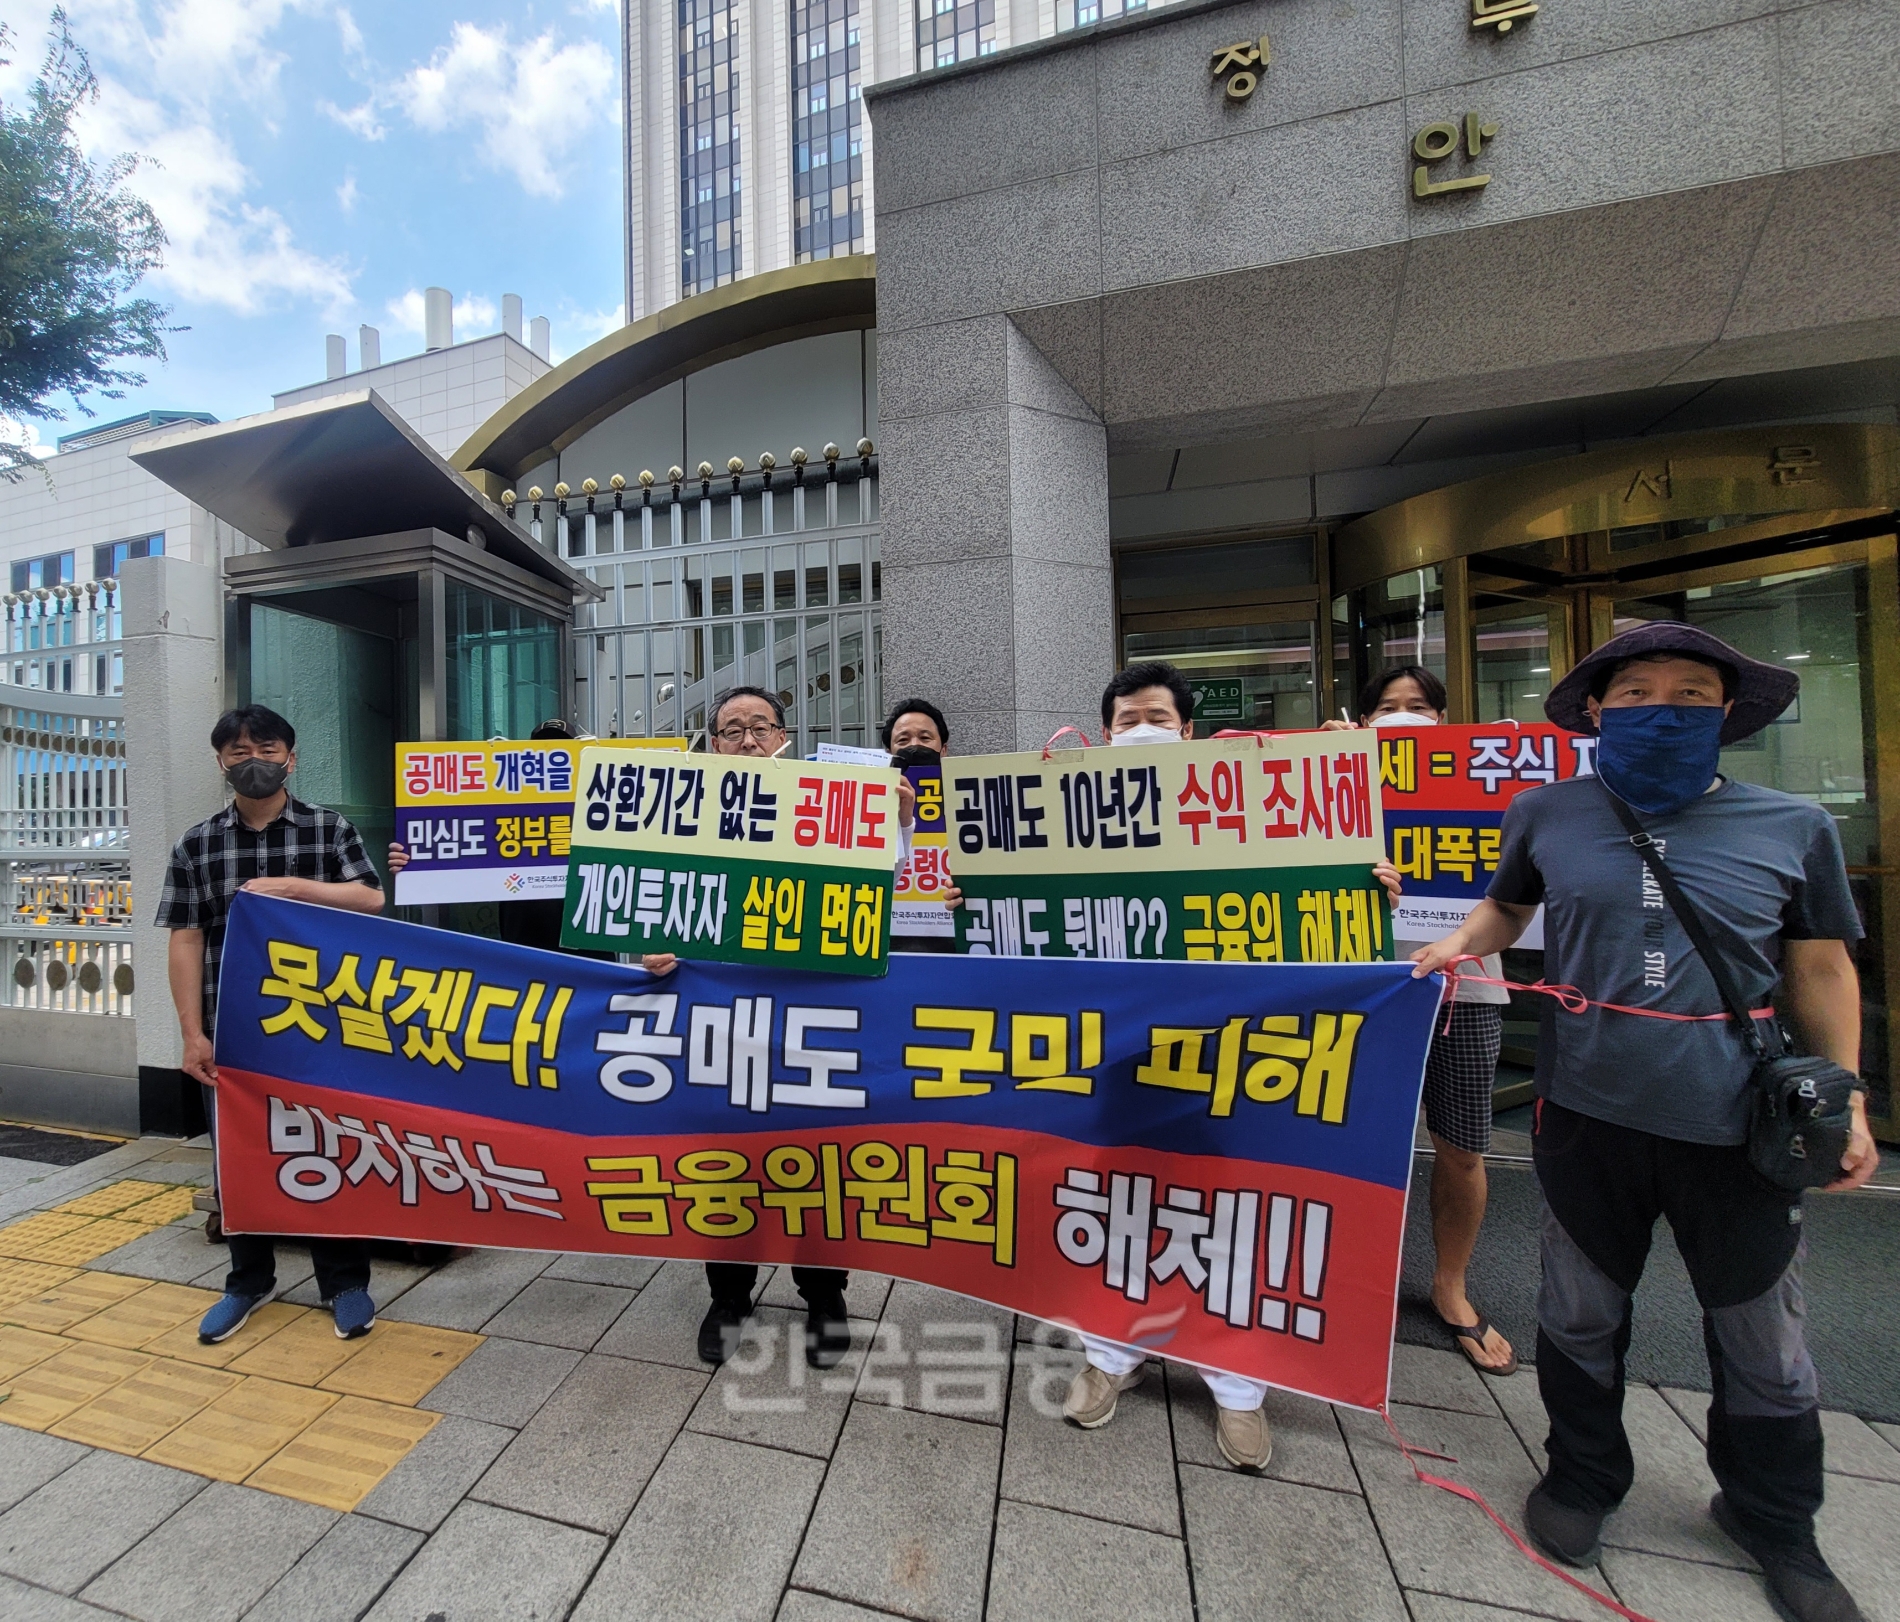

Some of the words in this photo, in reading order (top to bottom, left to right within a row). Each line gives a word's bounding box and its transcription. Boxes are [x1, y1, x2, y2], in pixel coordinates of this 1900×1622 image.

[1207, 687, 1239, 698] AED
[405, 753, 486, 796] 공매도
[494, 750, 573, 792] 개혁을
[1468, 736, 1556, 793] 주식
[406, 818, 487, 861] 민심도
[494, 813, 571, 859] 정부를
[586, 763, 705, 837] 상환기간
[719, 770, 778, 843] 없는
[793, 776, 888, 850] 공매도
[954, 774, 1048, 855] 공매도
[1060, 765, 1162, 849] 10년간
[1176, 760, 1247, 846] 수익
[1262, 752, 1373, 840] 조사해
[571, 863, 729, 946] 개인투자자
[741, 875, 806, 953] 살인
[819, 882, 885, 961] 면허
[964, 897, 1050, 958] 공매도
[1183, 891, 1284, 963] 금융위
[1643, 950, 1666, 988] STYLE
[259, 939, 574, 1091] 못살겠다!
[594, 992, 869, 1113] 공매도
[904, 1006, 1103, 1099] 국민
[1135, 1011, 1367, 1125] 피해
[266, 1095, 566, 1222] 방치하는
[585, 1140, 1018, 1267] 금융위원회
[1054, 1167, 1332, 1343] 해체!!
